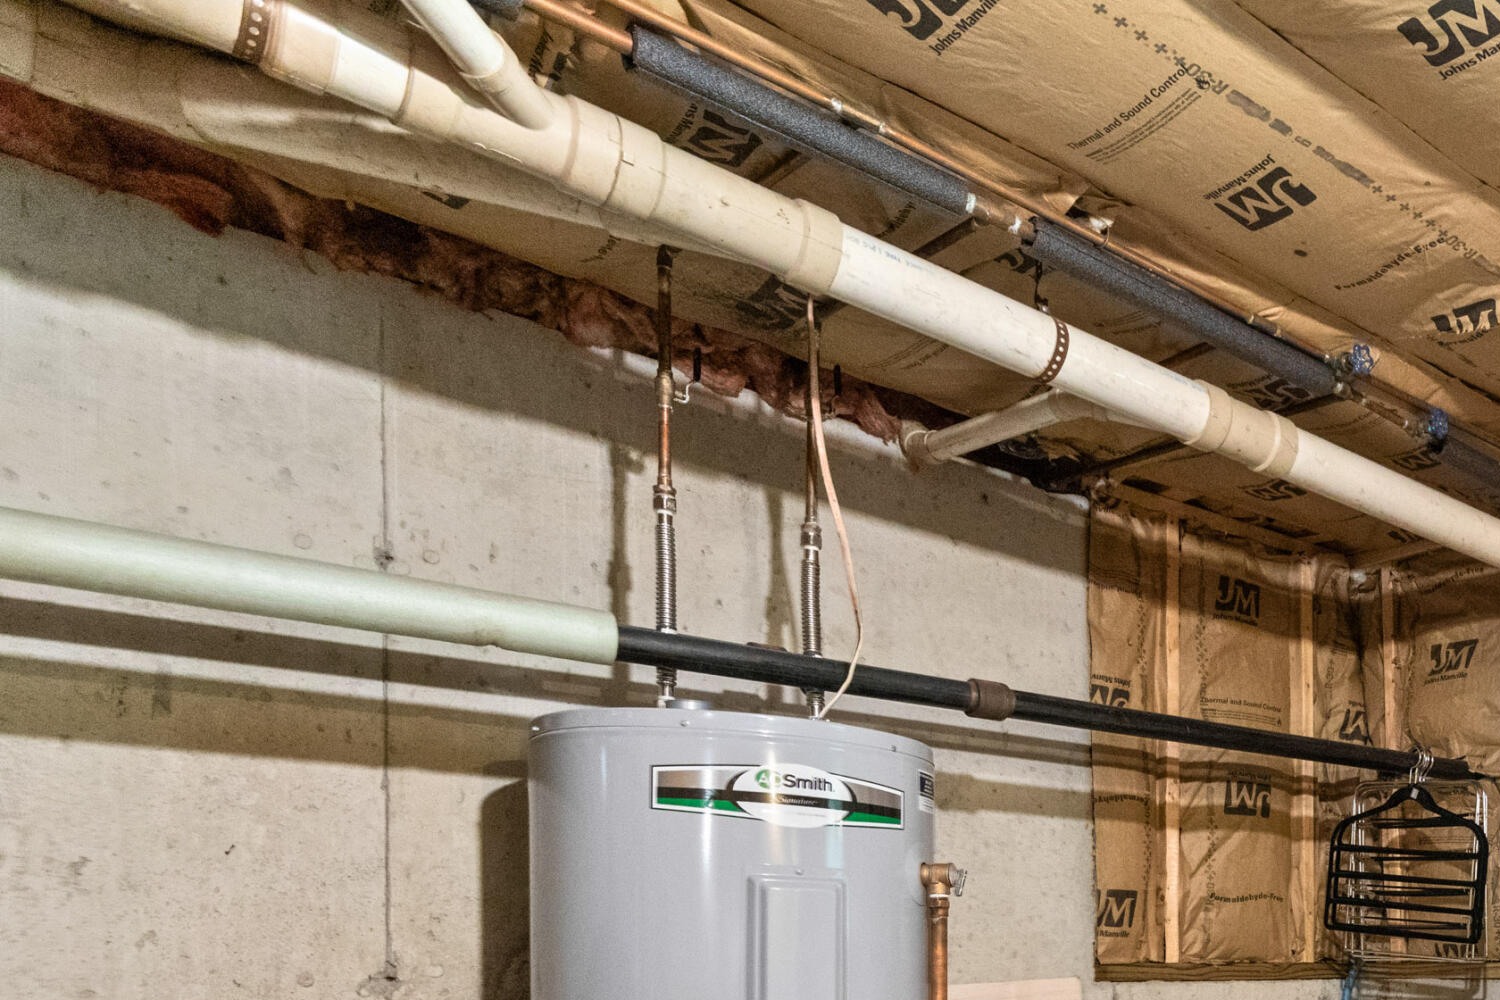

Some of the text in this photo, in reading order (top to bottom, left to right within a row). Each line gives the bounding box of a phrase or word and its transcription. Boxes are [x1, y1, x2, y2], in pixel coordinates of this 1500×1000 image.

[929, 28, 962, 56] Johns
[1438, 58, 1478, 81] Johns
[1067, 63, 1190, 151] Thermal and Sound Control
[1202, 154, 1277, 201] Johns Manville
[1213, 166, 1318, 232] JM
[1214, 575, 1260, 619] JM
[1428, 638, 1479, 677] JM
[783, 774, 833, 792] Smith
[1224, 780, 1271, 818] JM
